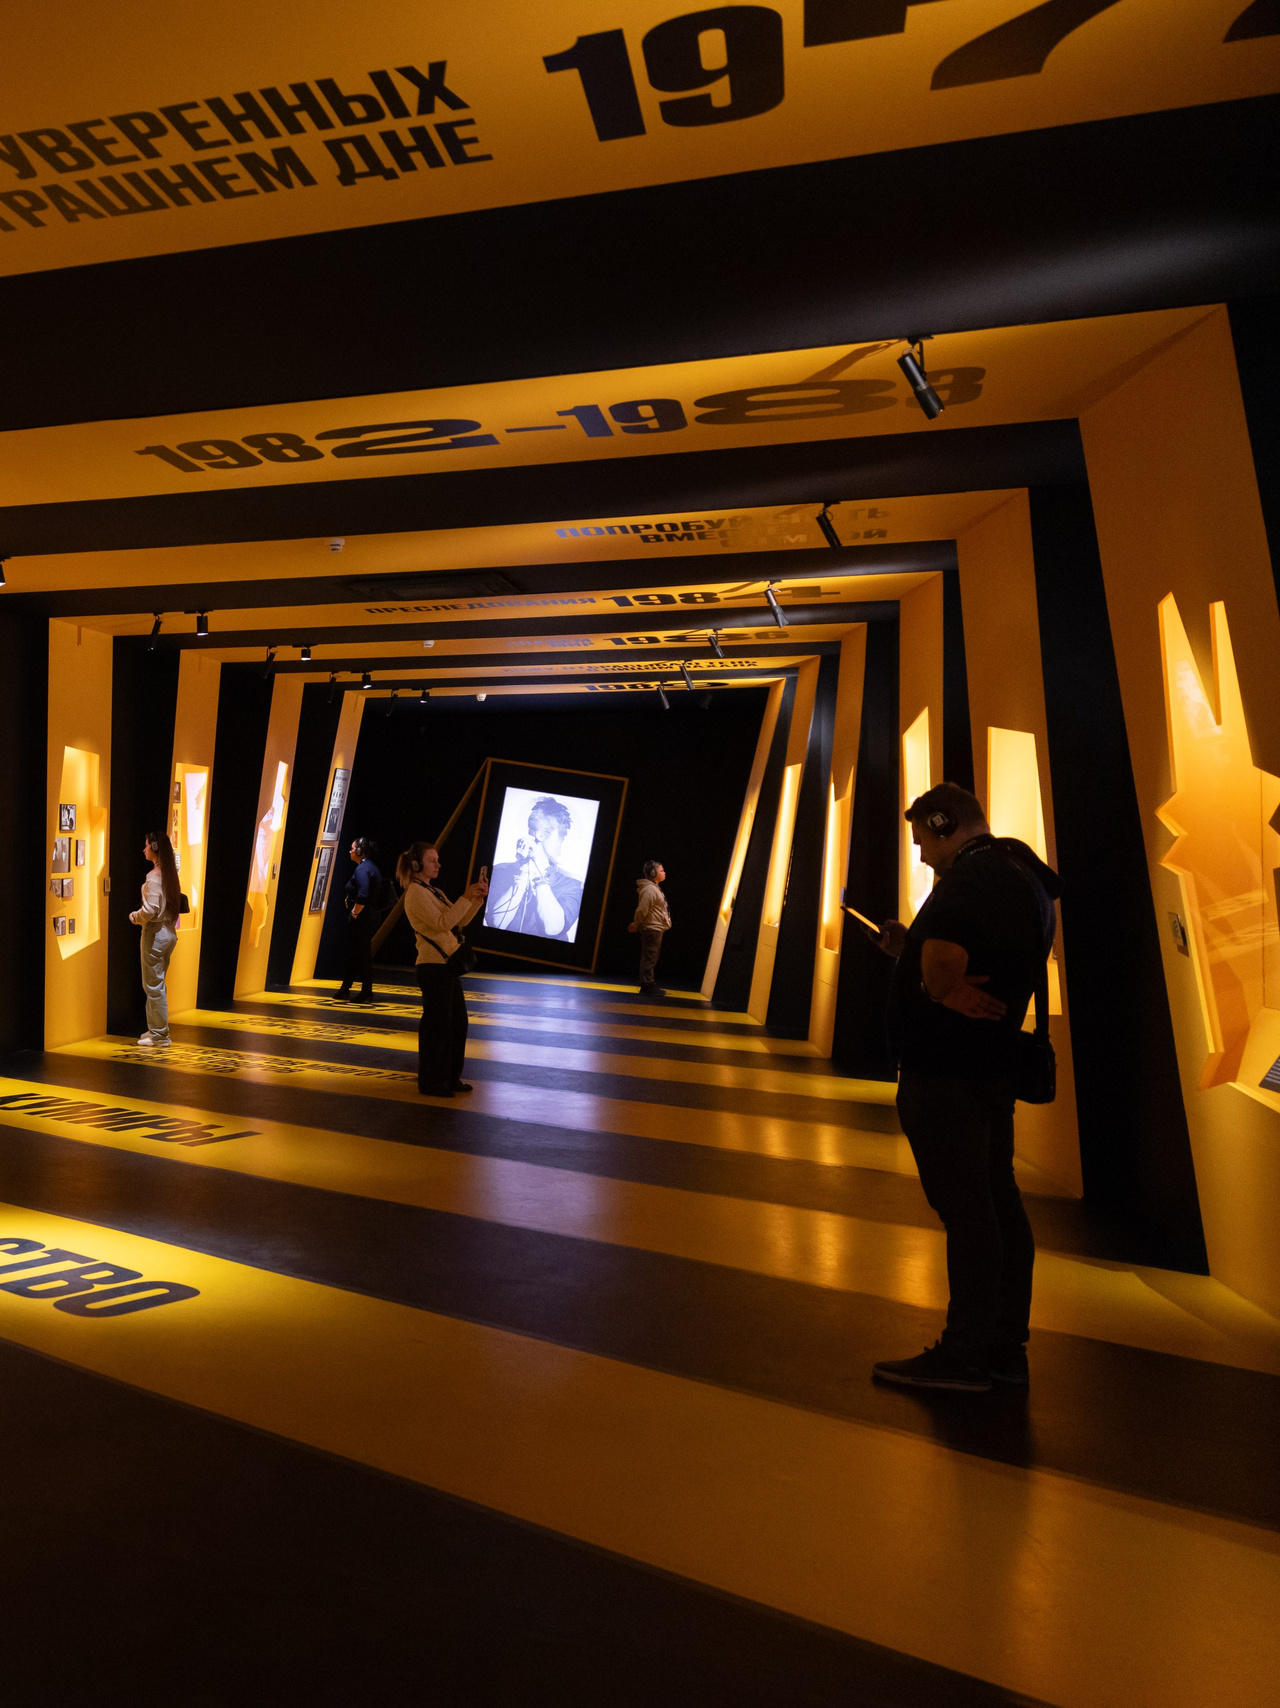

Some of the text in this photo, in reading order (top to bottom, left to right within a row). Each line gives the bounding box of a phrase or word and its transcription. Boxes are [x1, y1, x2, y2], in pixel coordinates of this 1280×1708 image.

[323, 118, 495, 187] ДНЕ
[364, 596, 597, 614] ПРЕСЛЕДОВАНИЯ
[603, 630, 789, 646] 1986
